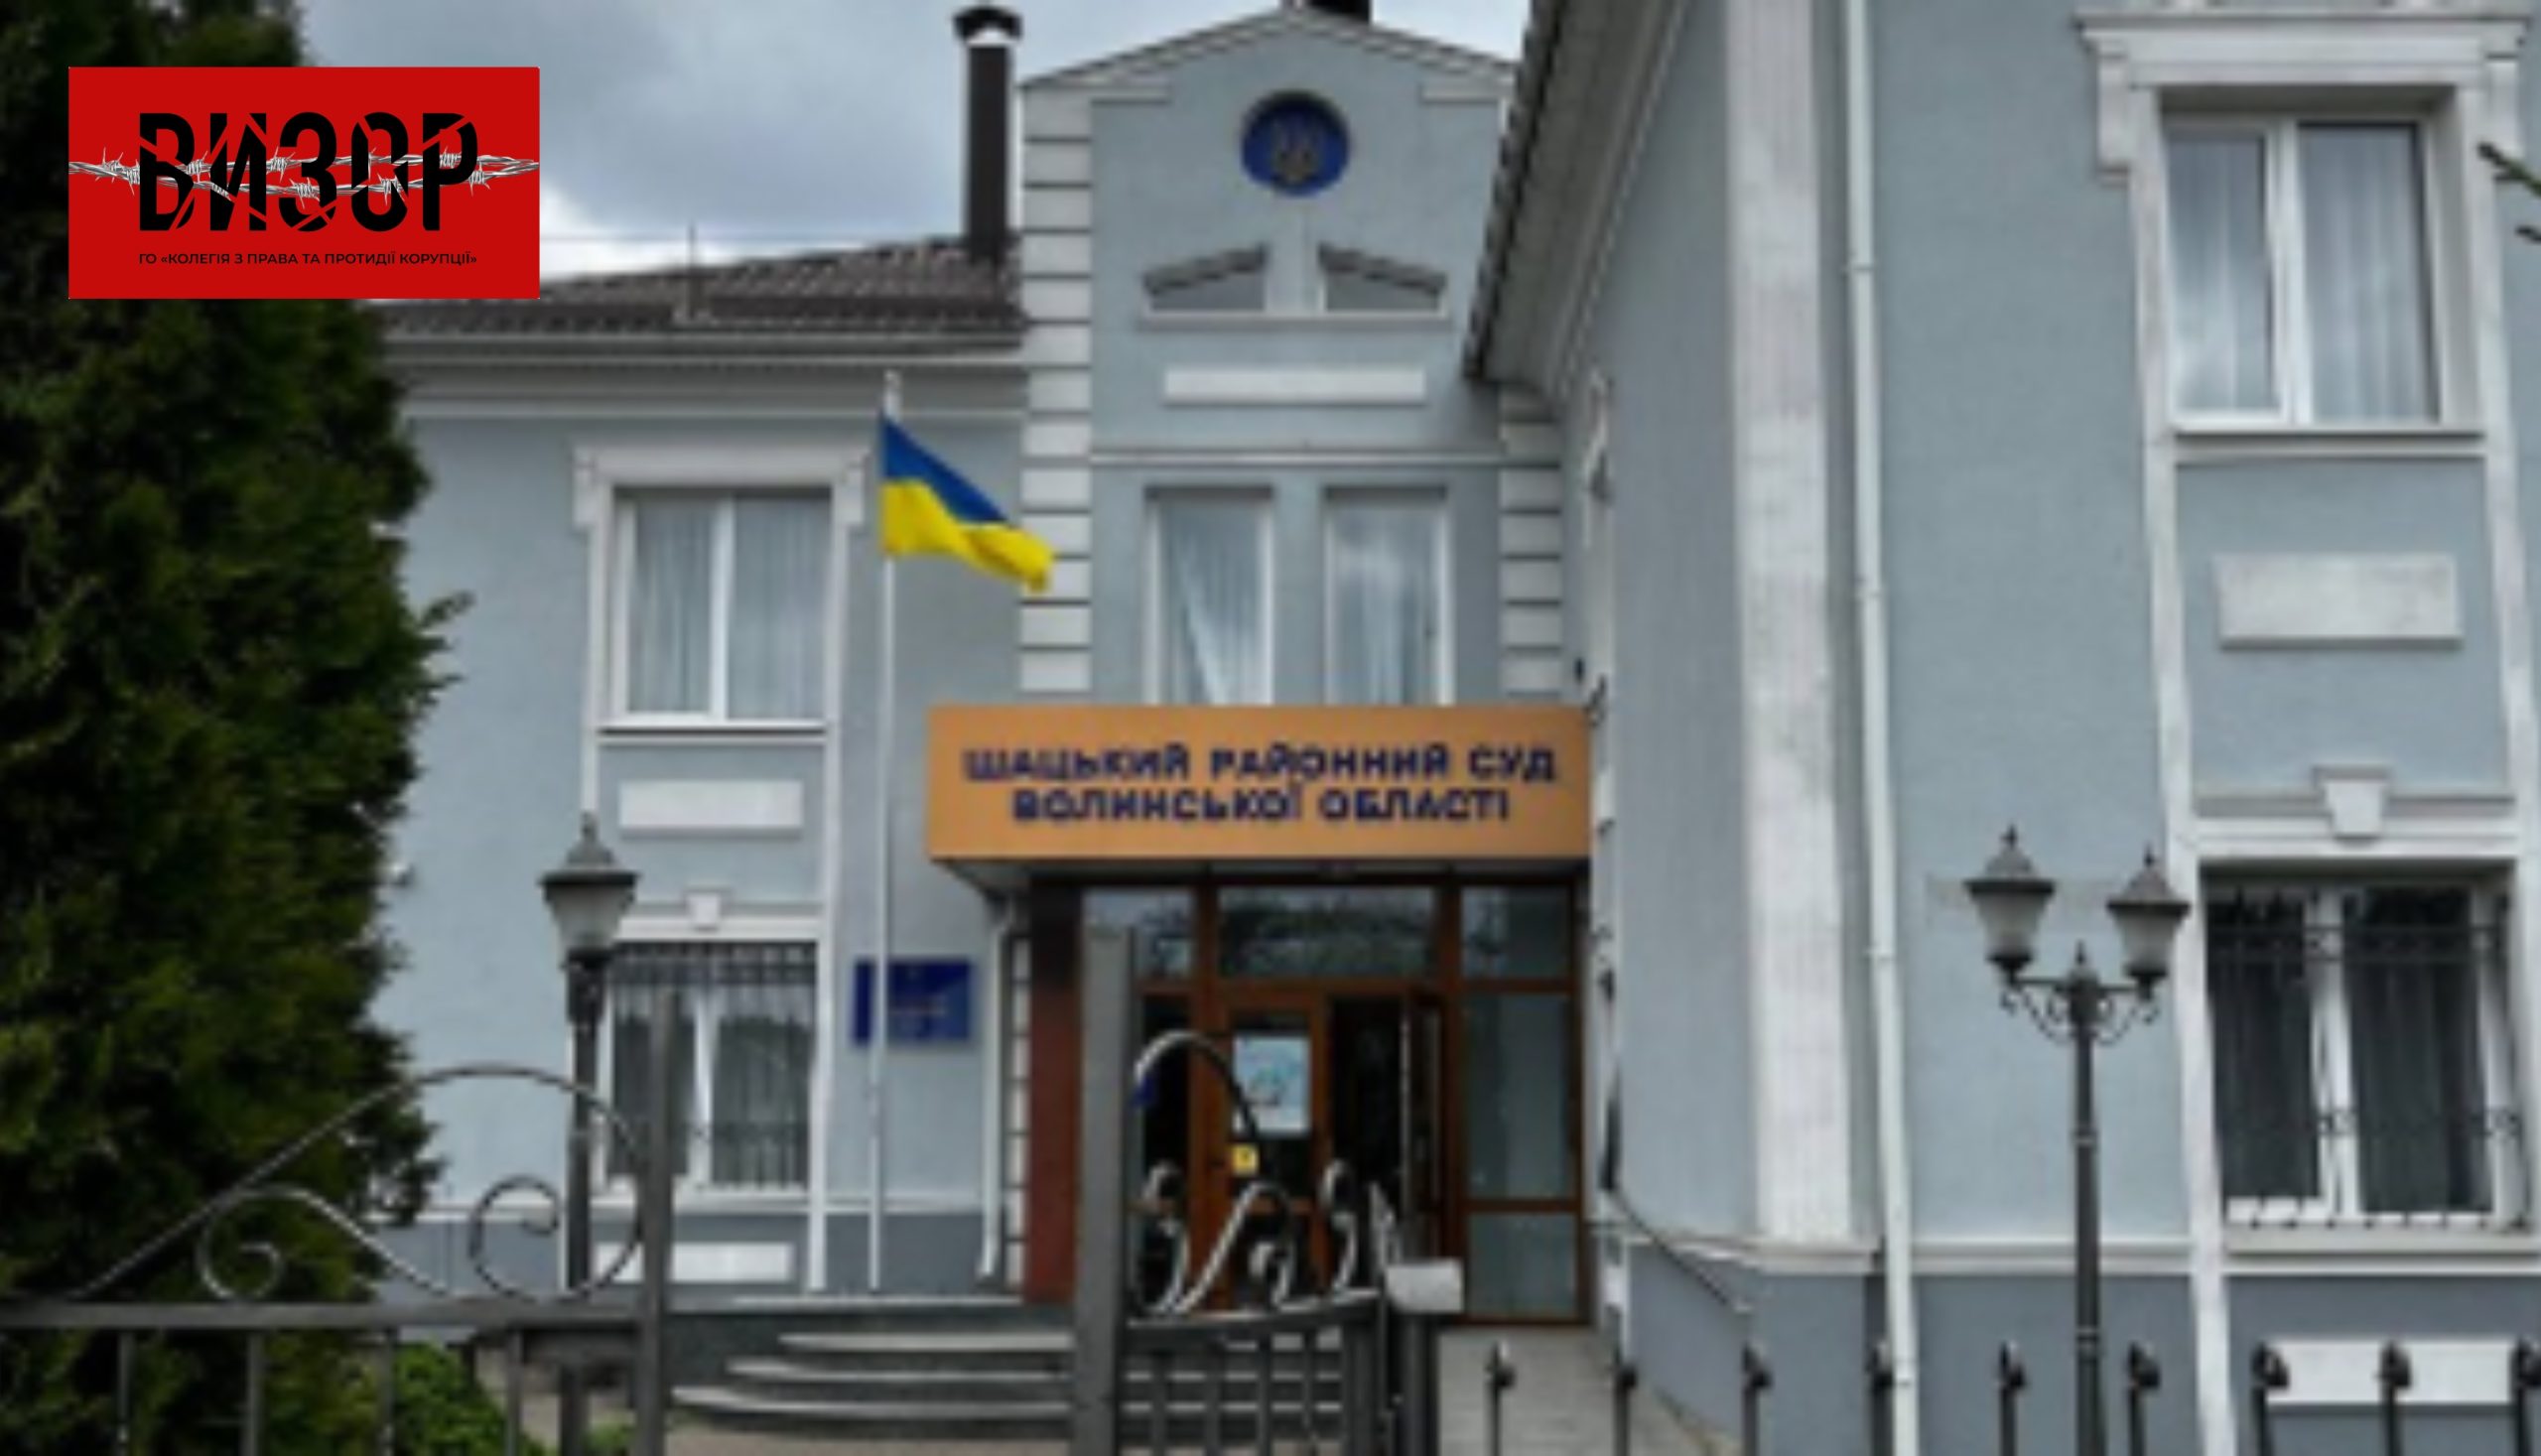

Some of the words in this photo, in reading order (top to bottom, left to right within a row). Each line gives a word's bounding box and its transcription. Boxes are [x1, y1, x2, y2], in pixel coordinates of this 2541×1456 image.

[963, 742, 1190, 782] ШАЦЬКИЙ
[1210, 741, 1451, 782] РАЙОННИЙ
[1468, 746, 1557, 782] СУД
[1012, 782, 1302, 822] ВОЛИНСЬКОЇ
[1318, 787, 1511, 822] ОБЛАСТІ
